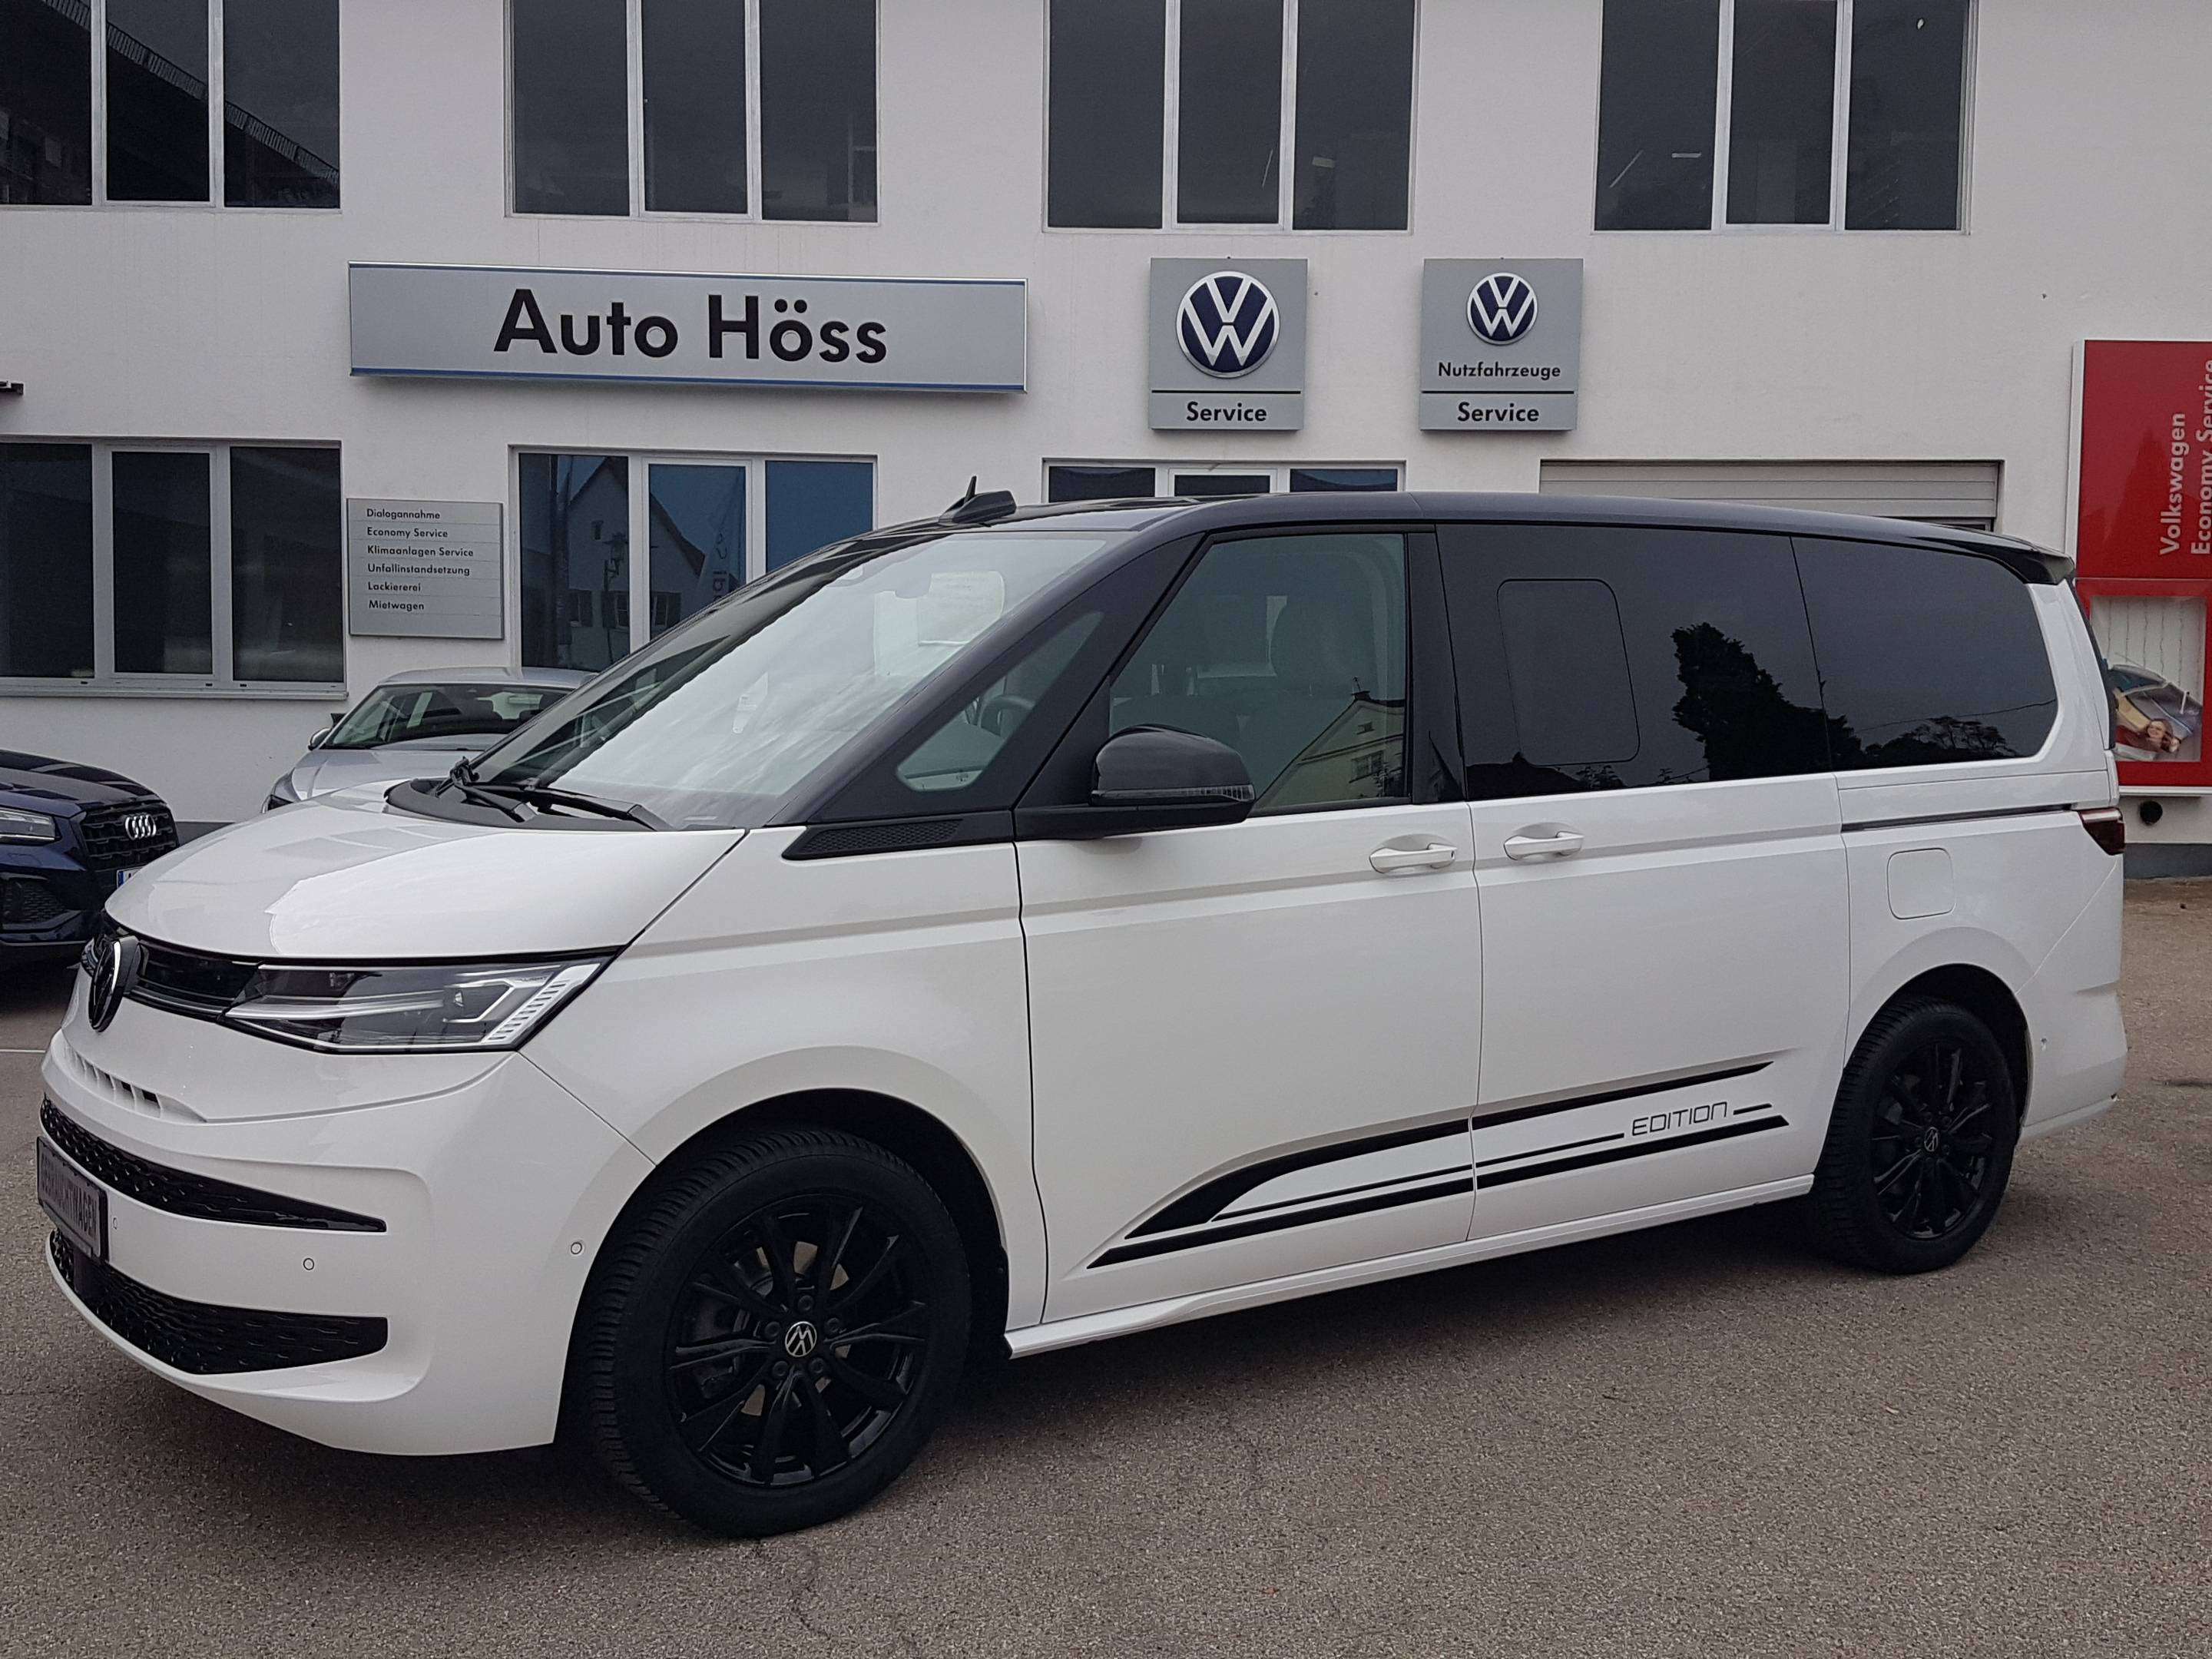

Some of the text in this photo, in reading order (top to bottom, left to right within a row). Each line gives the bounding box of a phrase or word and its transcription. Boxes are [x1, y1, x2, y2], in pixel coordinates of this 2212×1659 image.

[1466, 272, 1538, 346] VW
[493, 288, 887, 364] Auto Höss
[1176, 271, 1280, 379] VW
[1438, 361, 1561, 381] Nutzfahrzeuge
[1186, 401, 1267, 422] Service
[1457, 401, 1539, 422] Service
[2160, 413, 2189, 555] Volkswagen
[2190, 450, 2212, 555] Economy
[366, 508, 440, 520] Dialogannahme
[367, 526, 448, 539] Economy Service
[367, 545, 474, 558] Klimaanlagen Service
[367, 563, 470, 577] Unfallinstandsetzung
[368, 581, 422, 591] Lackiererei
[369, 599, 425, 612] Mietwagen
[1632, 1101, 1728, 1136] EDITION
